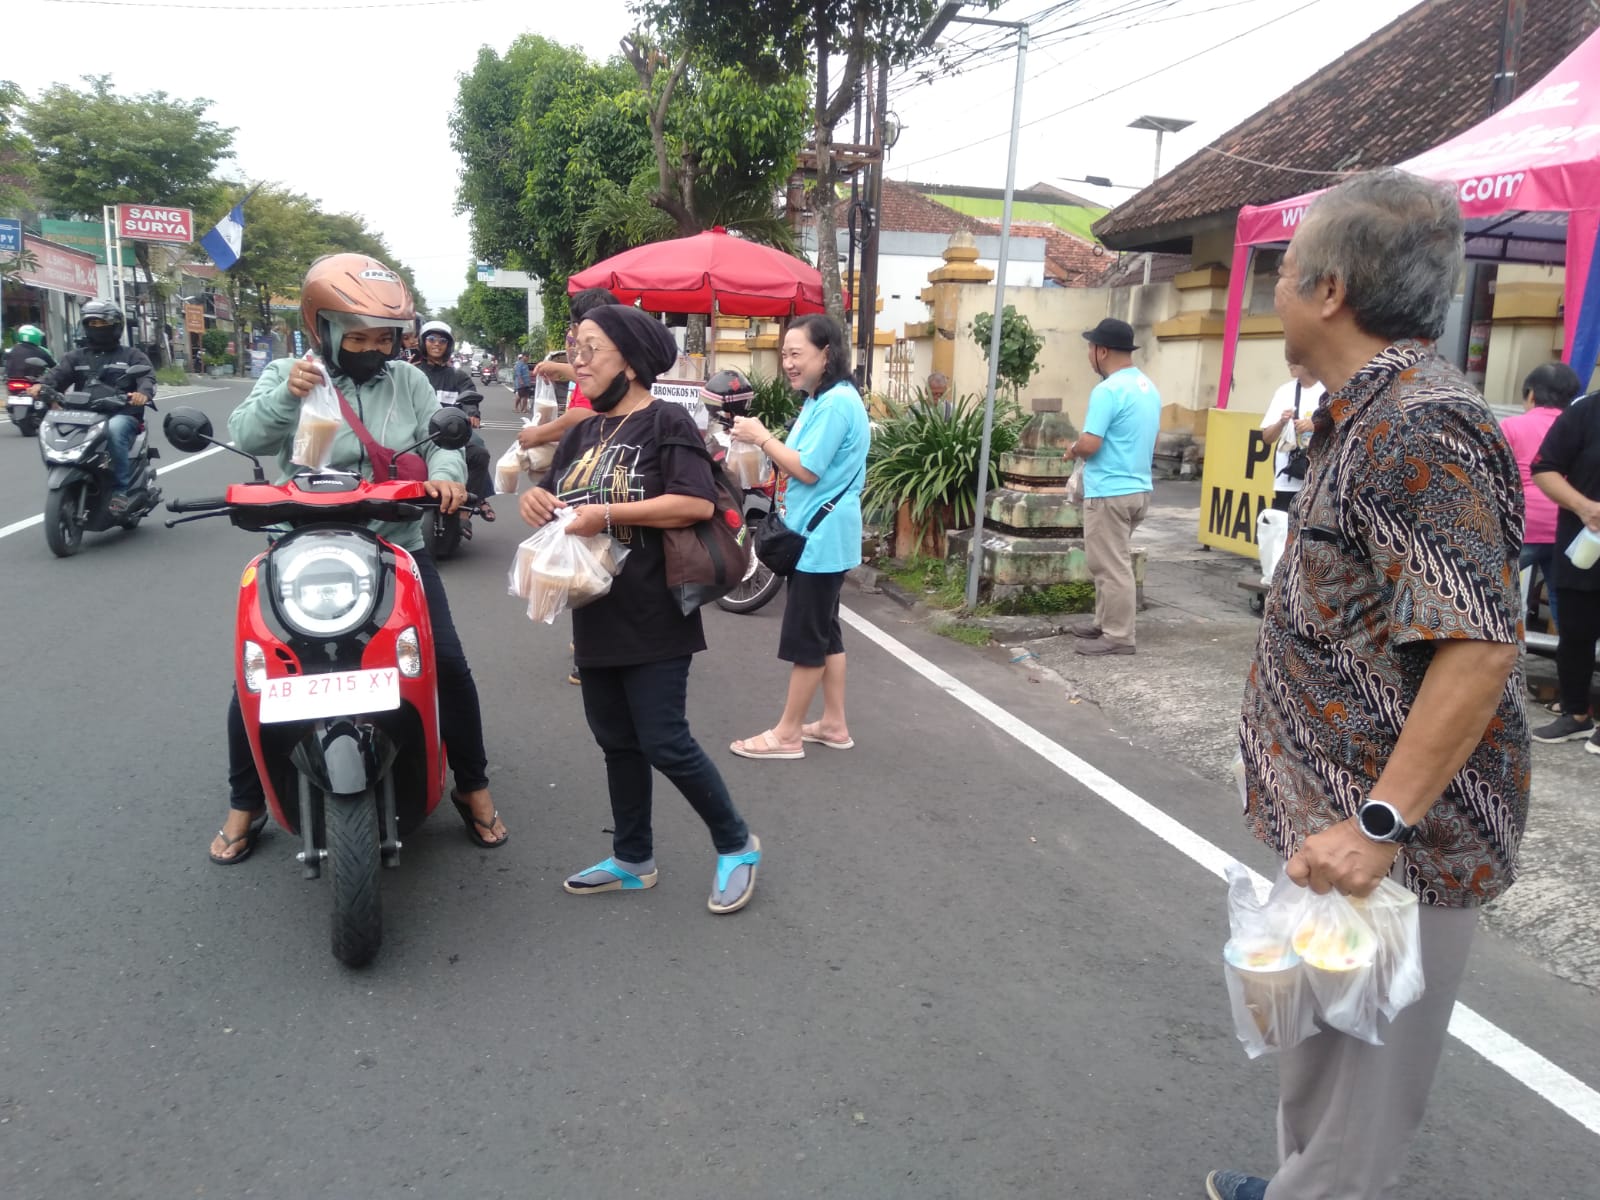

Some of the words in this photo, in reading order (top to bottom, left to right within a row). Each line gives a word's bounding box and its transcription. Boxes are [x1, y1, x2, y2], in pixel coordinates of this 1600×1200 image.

[129, 208, 182, 222] SANG
[125, 219, 187, 235] SURYA
[653, 386, 688, 398] BRONGKOS
[268, 681, 292, 699] AB
[308, 675, 356, 695] 2715
[369, 672, 393, 689] XY
